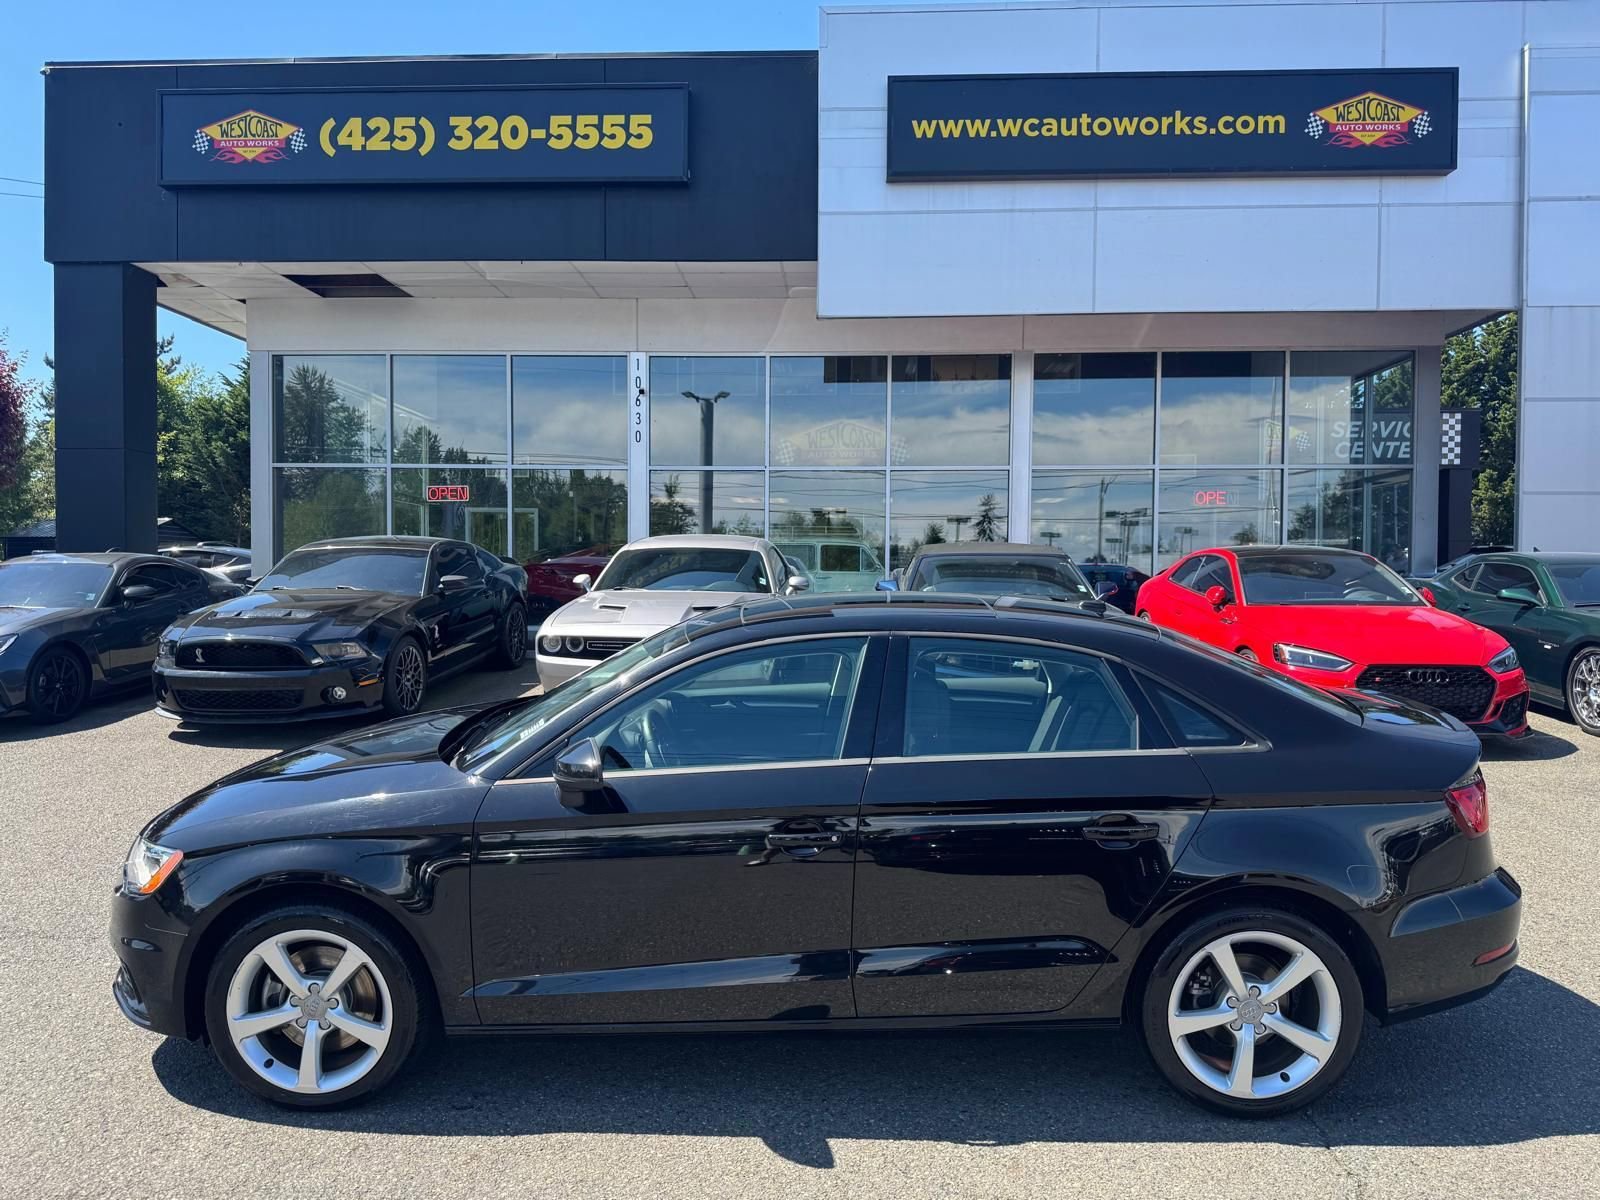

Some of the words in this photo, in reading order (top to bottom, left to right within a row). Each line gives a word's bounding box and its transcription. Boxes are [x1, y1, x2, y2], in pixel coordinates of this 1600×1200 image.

[911, 111, 1286, 139] www.wcautoworks.com
[1335, 123, 1363, 131] AUTO
[1365, 123, 1401, 131] WORKS
[319, 116, 436, 157] (425)
[447, 114, 654, 150] 320-5555
[1330, 420, 1411, 438] SEVIC
[1334, 441, 1411, 458] CENTE
[428, 487, 467, 500] OPEN
